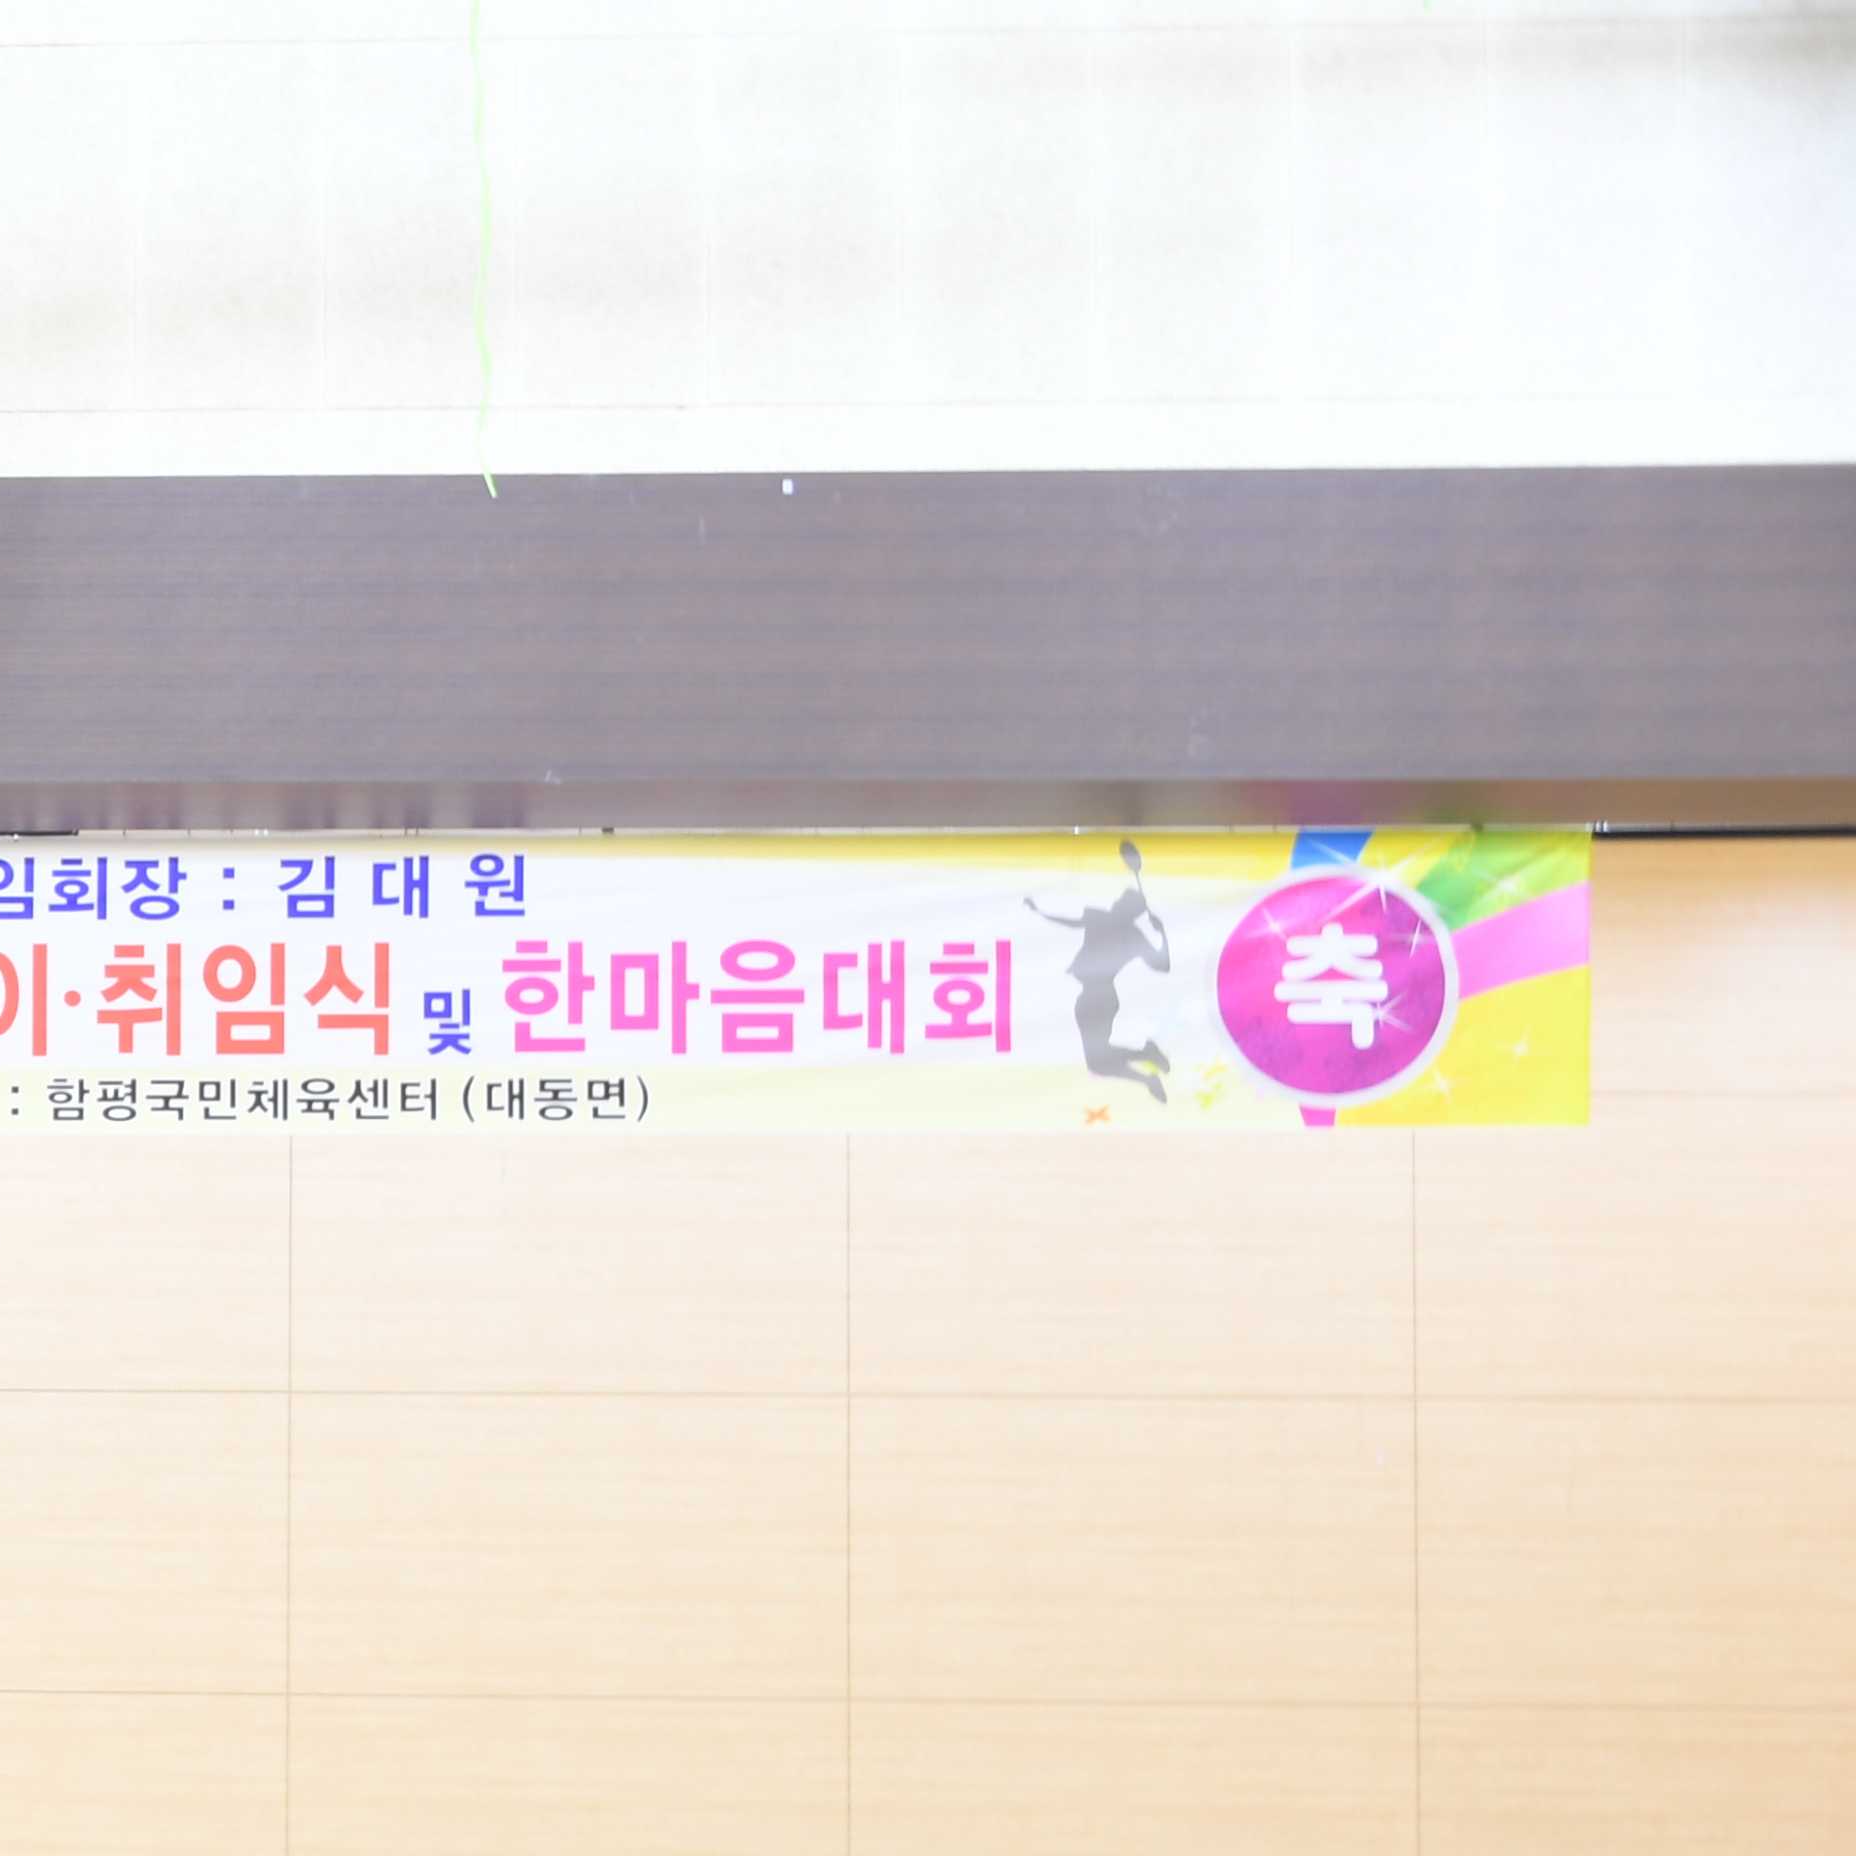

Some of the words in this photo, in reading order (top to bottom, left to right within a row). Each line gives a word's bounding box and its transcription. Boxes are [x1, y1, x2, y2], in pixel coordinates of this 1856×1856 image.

[424, 988, 471, 1056] 및
[503, 939, 1011, 1055] 한마음대회
[1274, 924, 1389, 1050] 축
[48, 1078, 436, 1122] 함평국민체육센터
[463, 1076, 648, 1122] (대동면)
